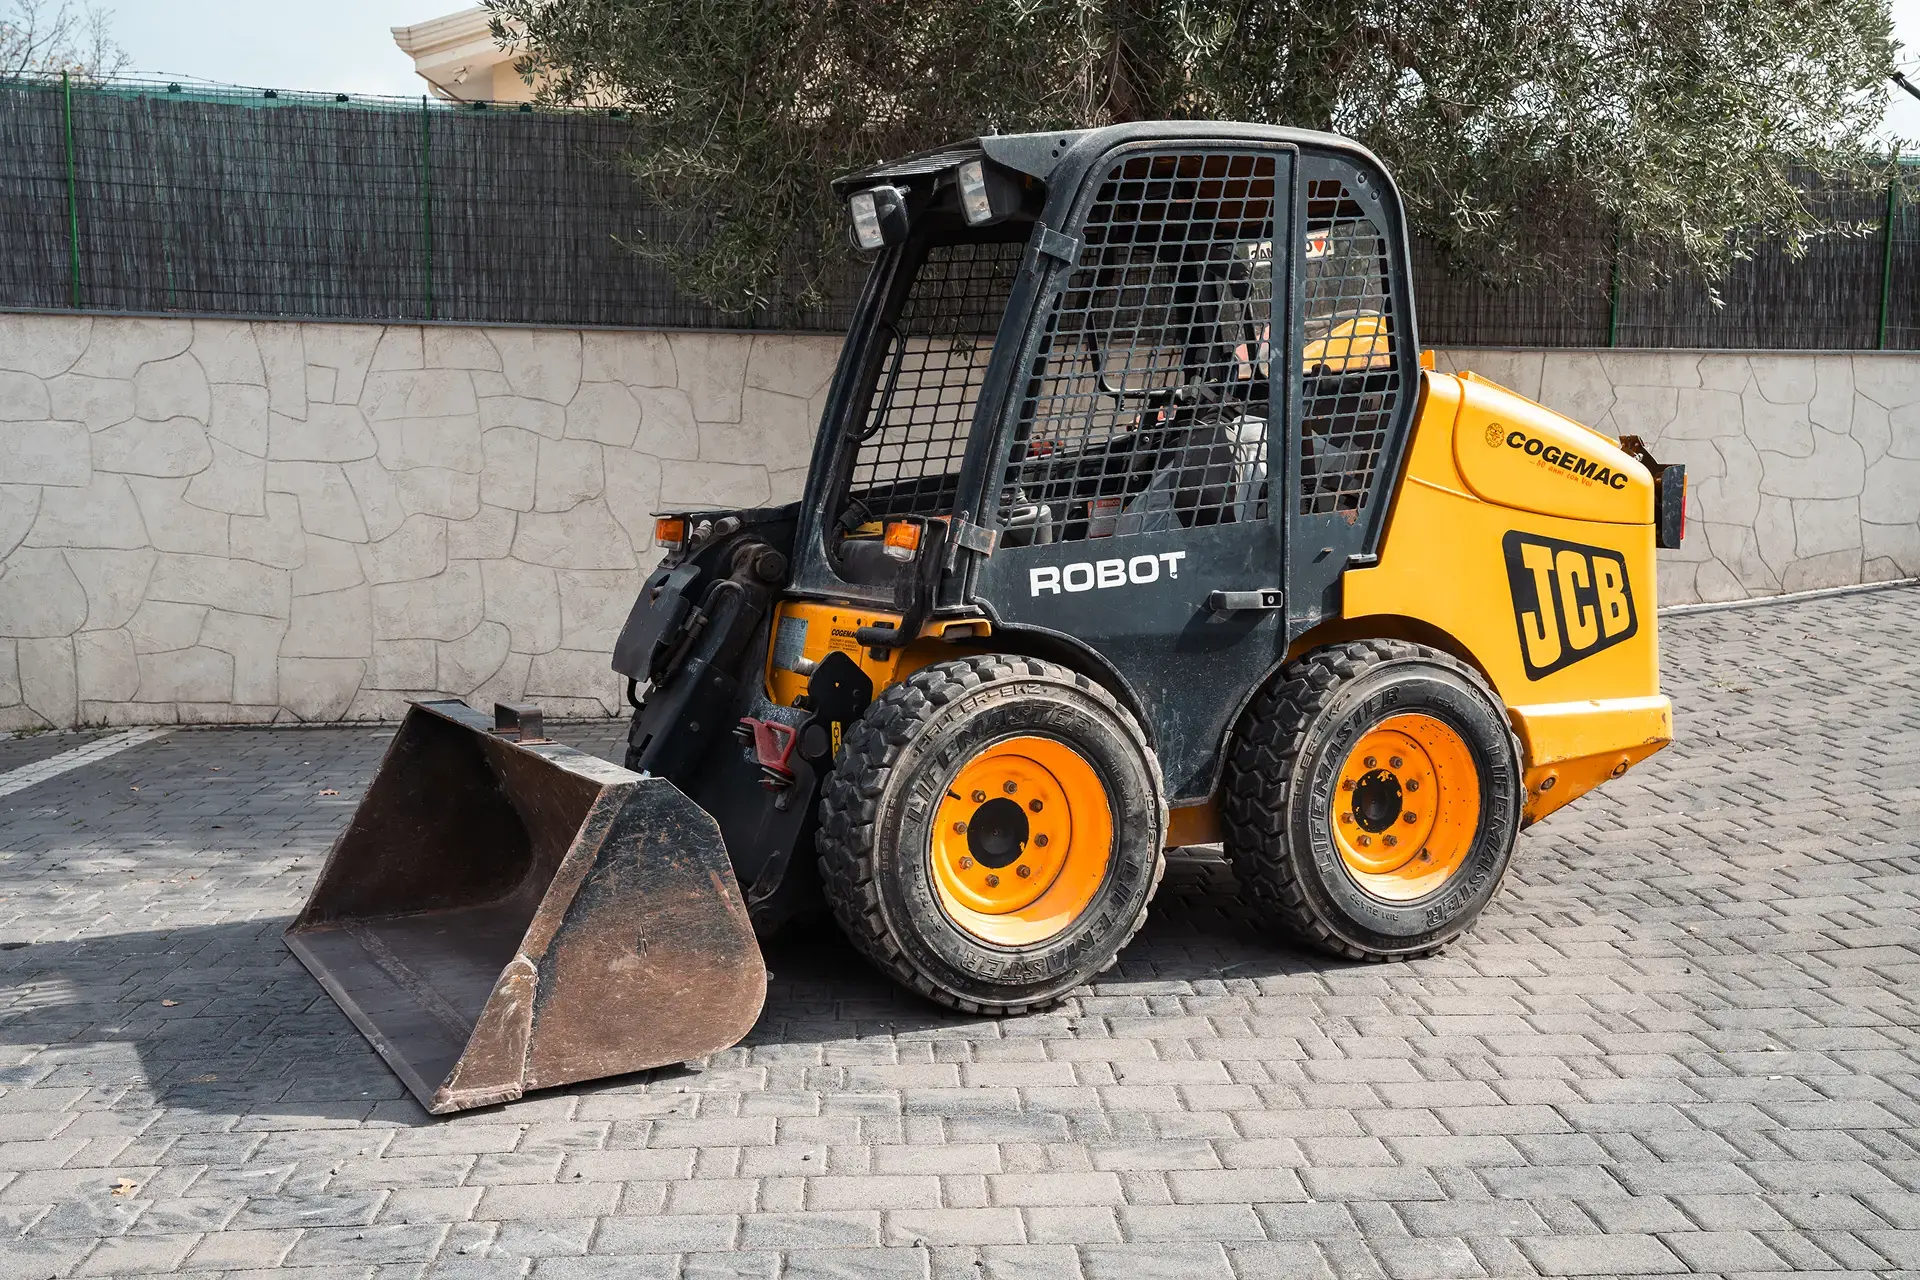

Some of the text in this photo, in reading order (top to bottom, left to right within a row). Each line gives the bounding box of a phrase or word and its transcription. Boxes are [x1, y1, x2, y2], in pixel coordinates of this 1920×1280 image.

[1506, 431, 1628, 490] COGEMAC
[1548, 465, 1565, 477] anni
[1029, 550, 1186, 597] ROBOT
[1520, 542, 1630, 668] JCB
[906, 702, 1093, 823] LIFEMASTER
[1310, 686, 1402, 876] LIFEMASTER
[1425, 740, 1509, 929] LIFEMASTER
[958, 859, 1140, 981] LIFEMASTER
